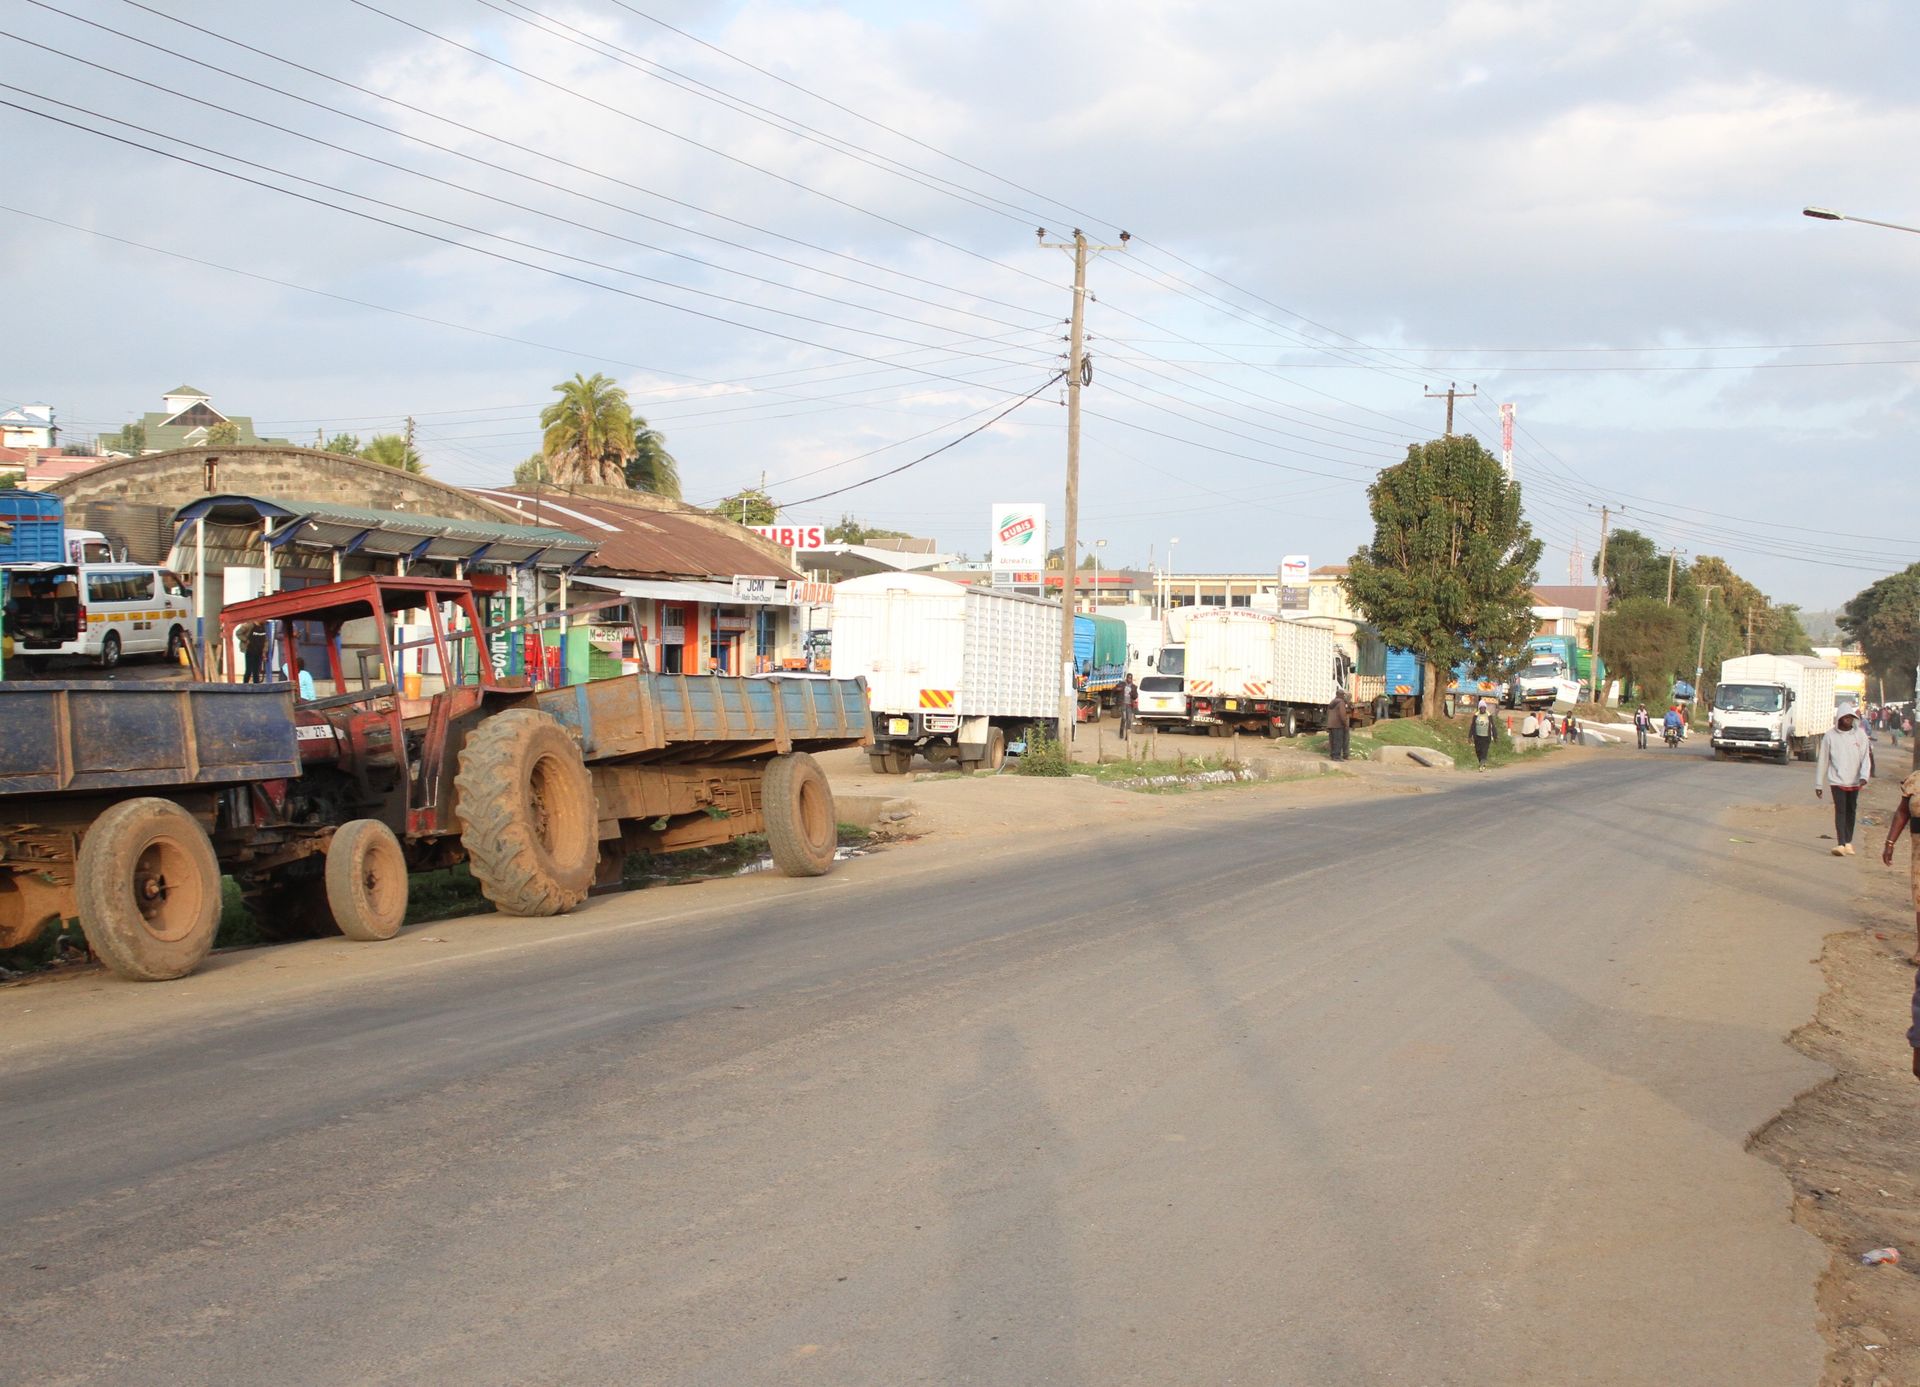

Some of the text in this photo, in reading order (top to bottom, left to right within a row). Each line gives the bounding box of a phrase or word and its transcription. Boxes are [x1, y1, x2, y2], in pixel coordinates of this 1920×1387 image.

[1002, 520, 1031, 539] RUBIS
[751, 528, 821, 548] UBiS
[747, 580, 764, 592] JCM
[313, 726, 326, 737] 275
